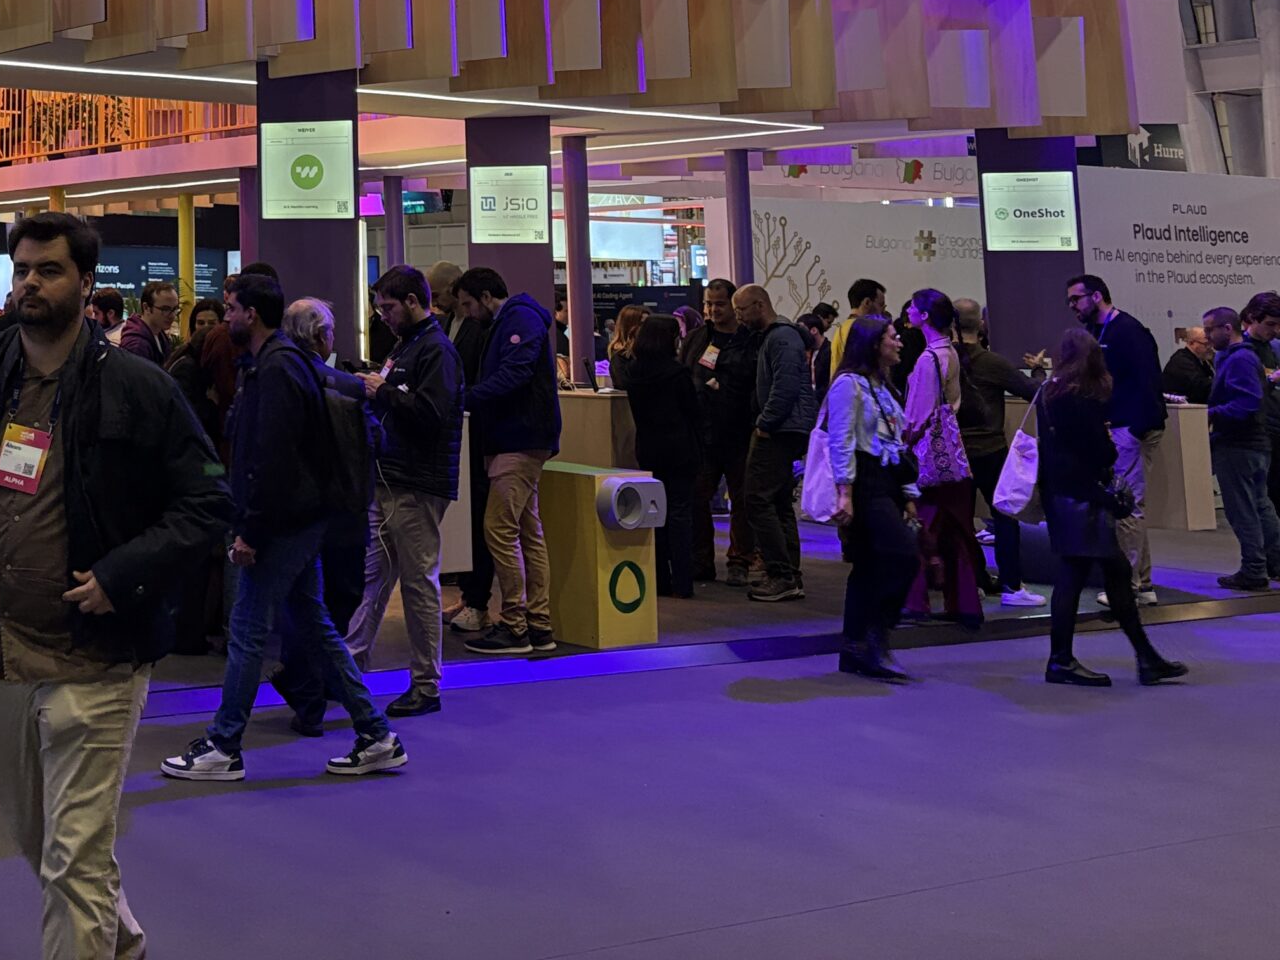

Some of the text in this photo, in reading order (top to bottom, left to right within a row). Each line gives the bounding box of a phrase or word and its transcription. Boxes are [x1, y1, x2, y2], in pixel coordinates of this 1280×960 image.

[1013, 207, 1066, 219] OneShot
[1172, 203, 1208, 216] PLAUD
[1133, 223, 1249, 247] Plaud Intelligence
[1092, 247, 1113, 262] The
[1115, 248, 1125, 262] AI
[1127, 250, 1165, 266] engine
[1166, 249, 1204, 265] behind
[1205, 253, 1232, 268] every
[1135, 268, 1256, 287] in the Plaud ecosystem.
